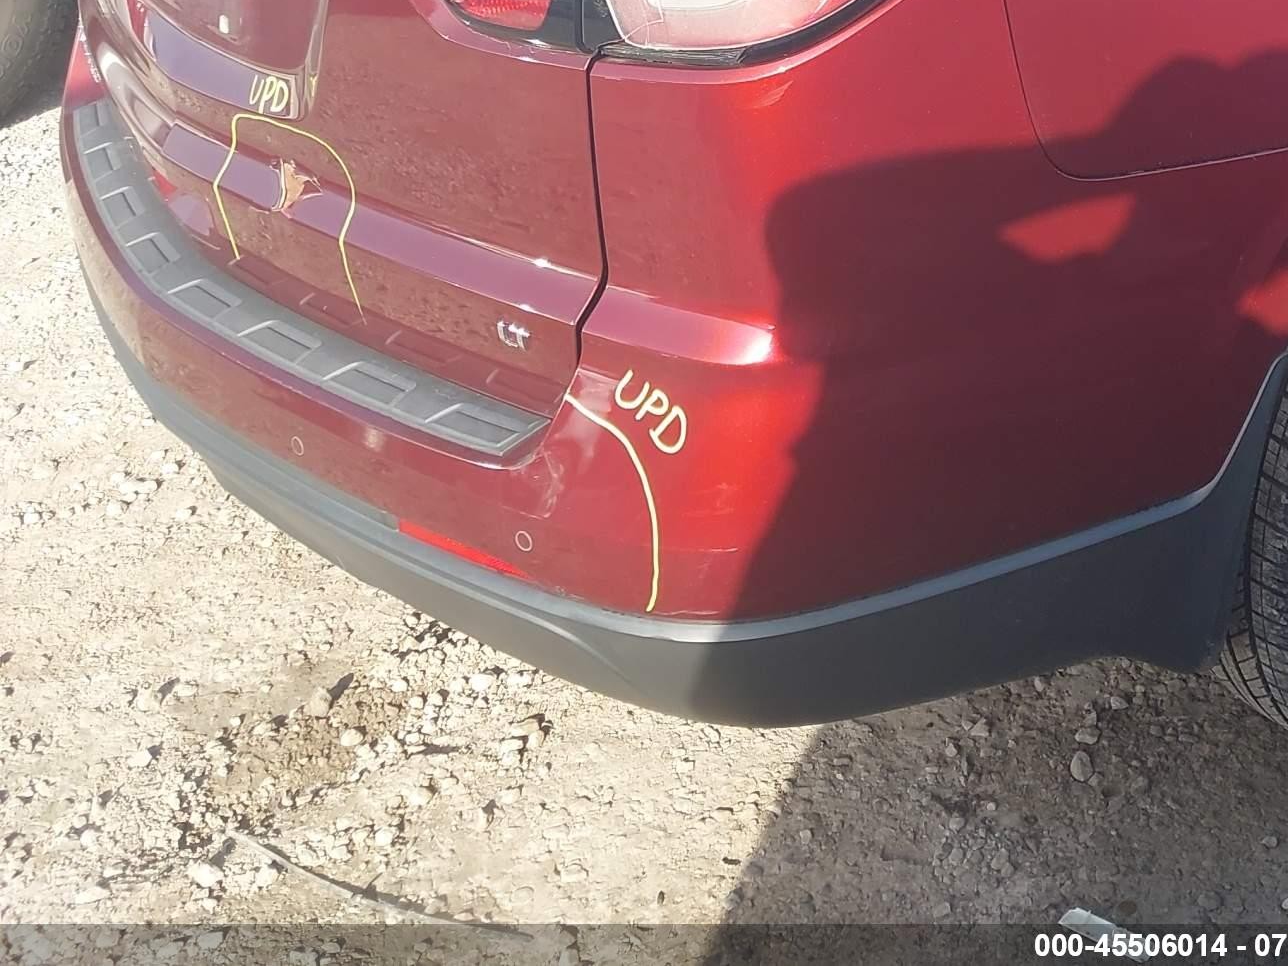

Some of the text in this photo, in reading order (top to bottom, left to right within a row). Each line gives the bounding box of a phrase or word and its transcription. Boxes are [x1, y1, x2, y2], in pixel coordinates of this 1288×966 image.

[249, 75, 289, 114] UPD
[496, 320, 530, 352] LT
[614, 369, 688, 454] UPD
